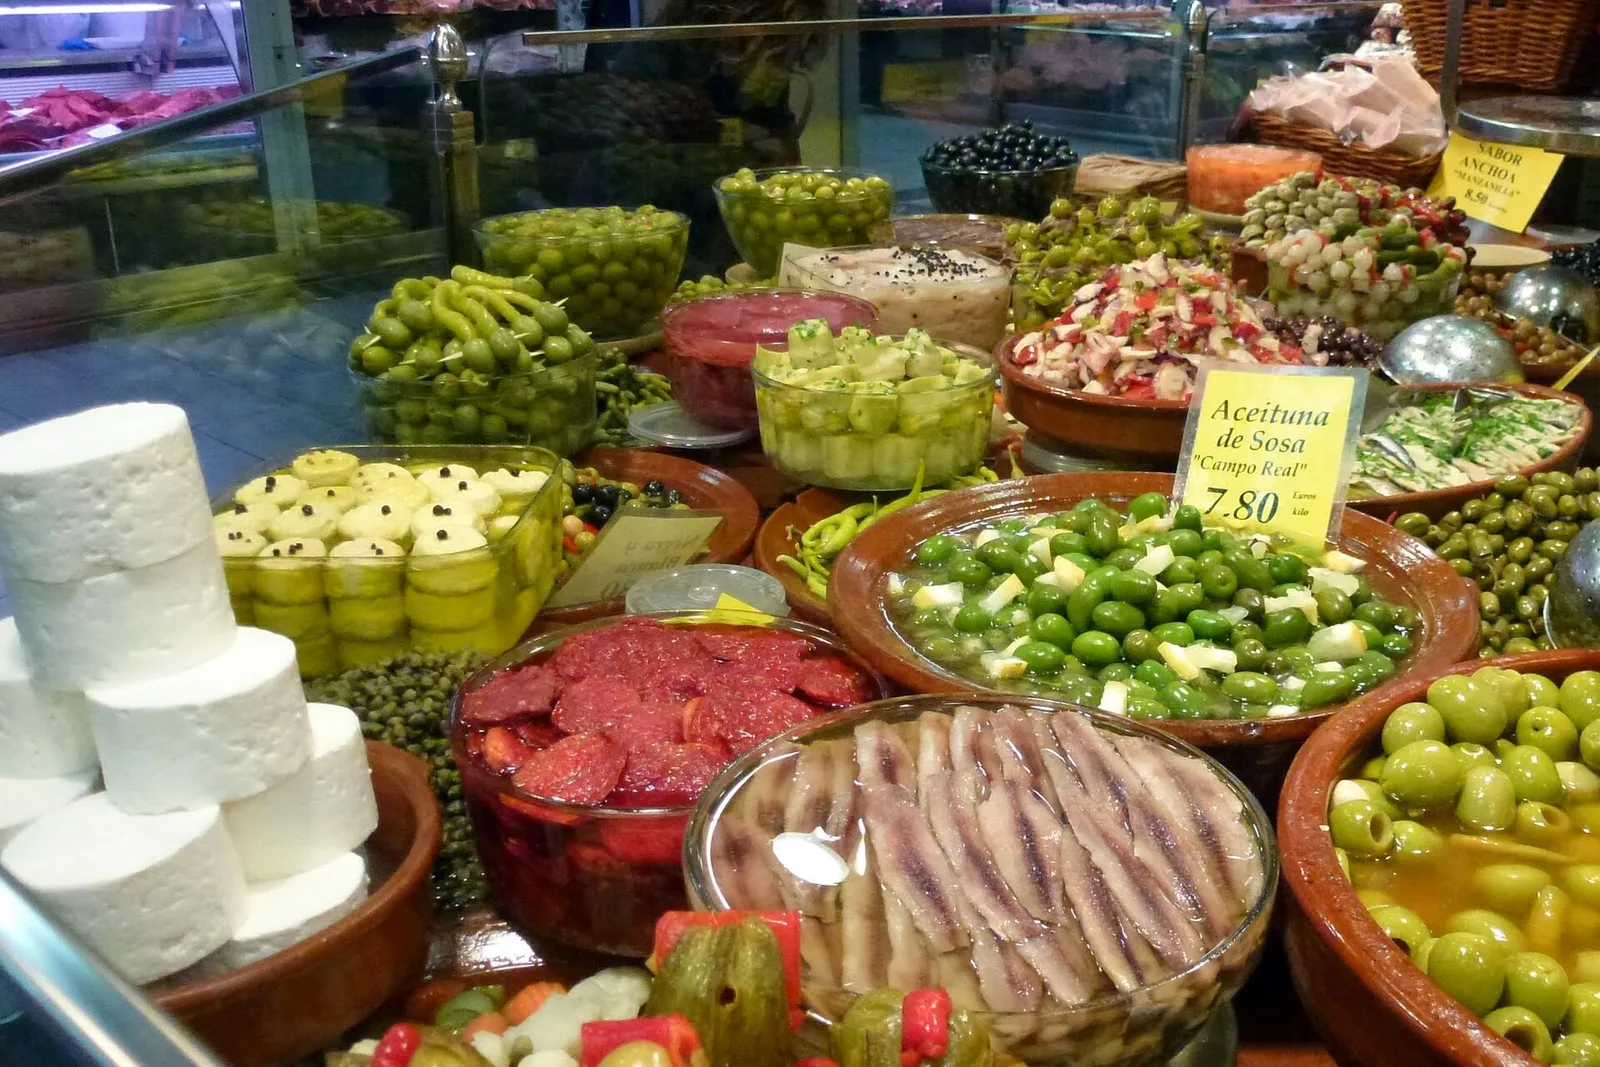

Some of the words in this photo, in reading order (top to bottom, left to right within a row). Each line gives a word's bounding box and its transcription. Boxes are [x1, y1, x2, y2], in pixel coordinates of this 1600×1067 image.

[1478, 142, 1523, 166] SABOR
[1459, 156, 1516, 184] ANCHOA
[1211, 399, 1330, 427] Aceituna
[1216, 427, 1244, 449] de
[1250, 430, 1306, 454] Sosa
[1194, 454, 1257, 478] "Campo
[1261, 460, 1308, 478] Real"
[1204, 486, 1279, 524] 7.80
[1292, 507, 1309, 517] kilo
